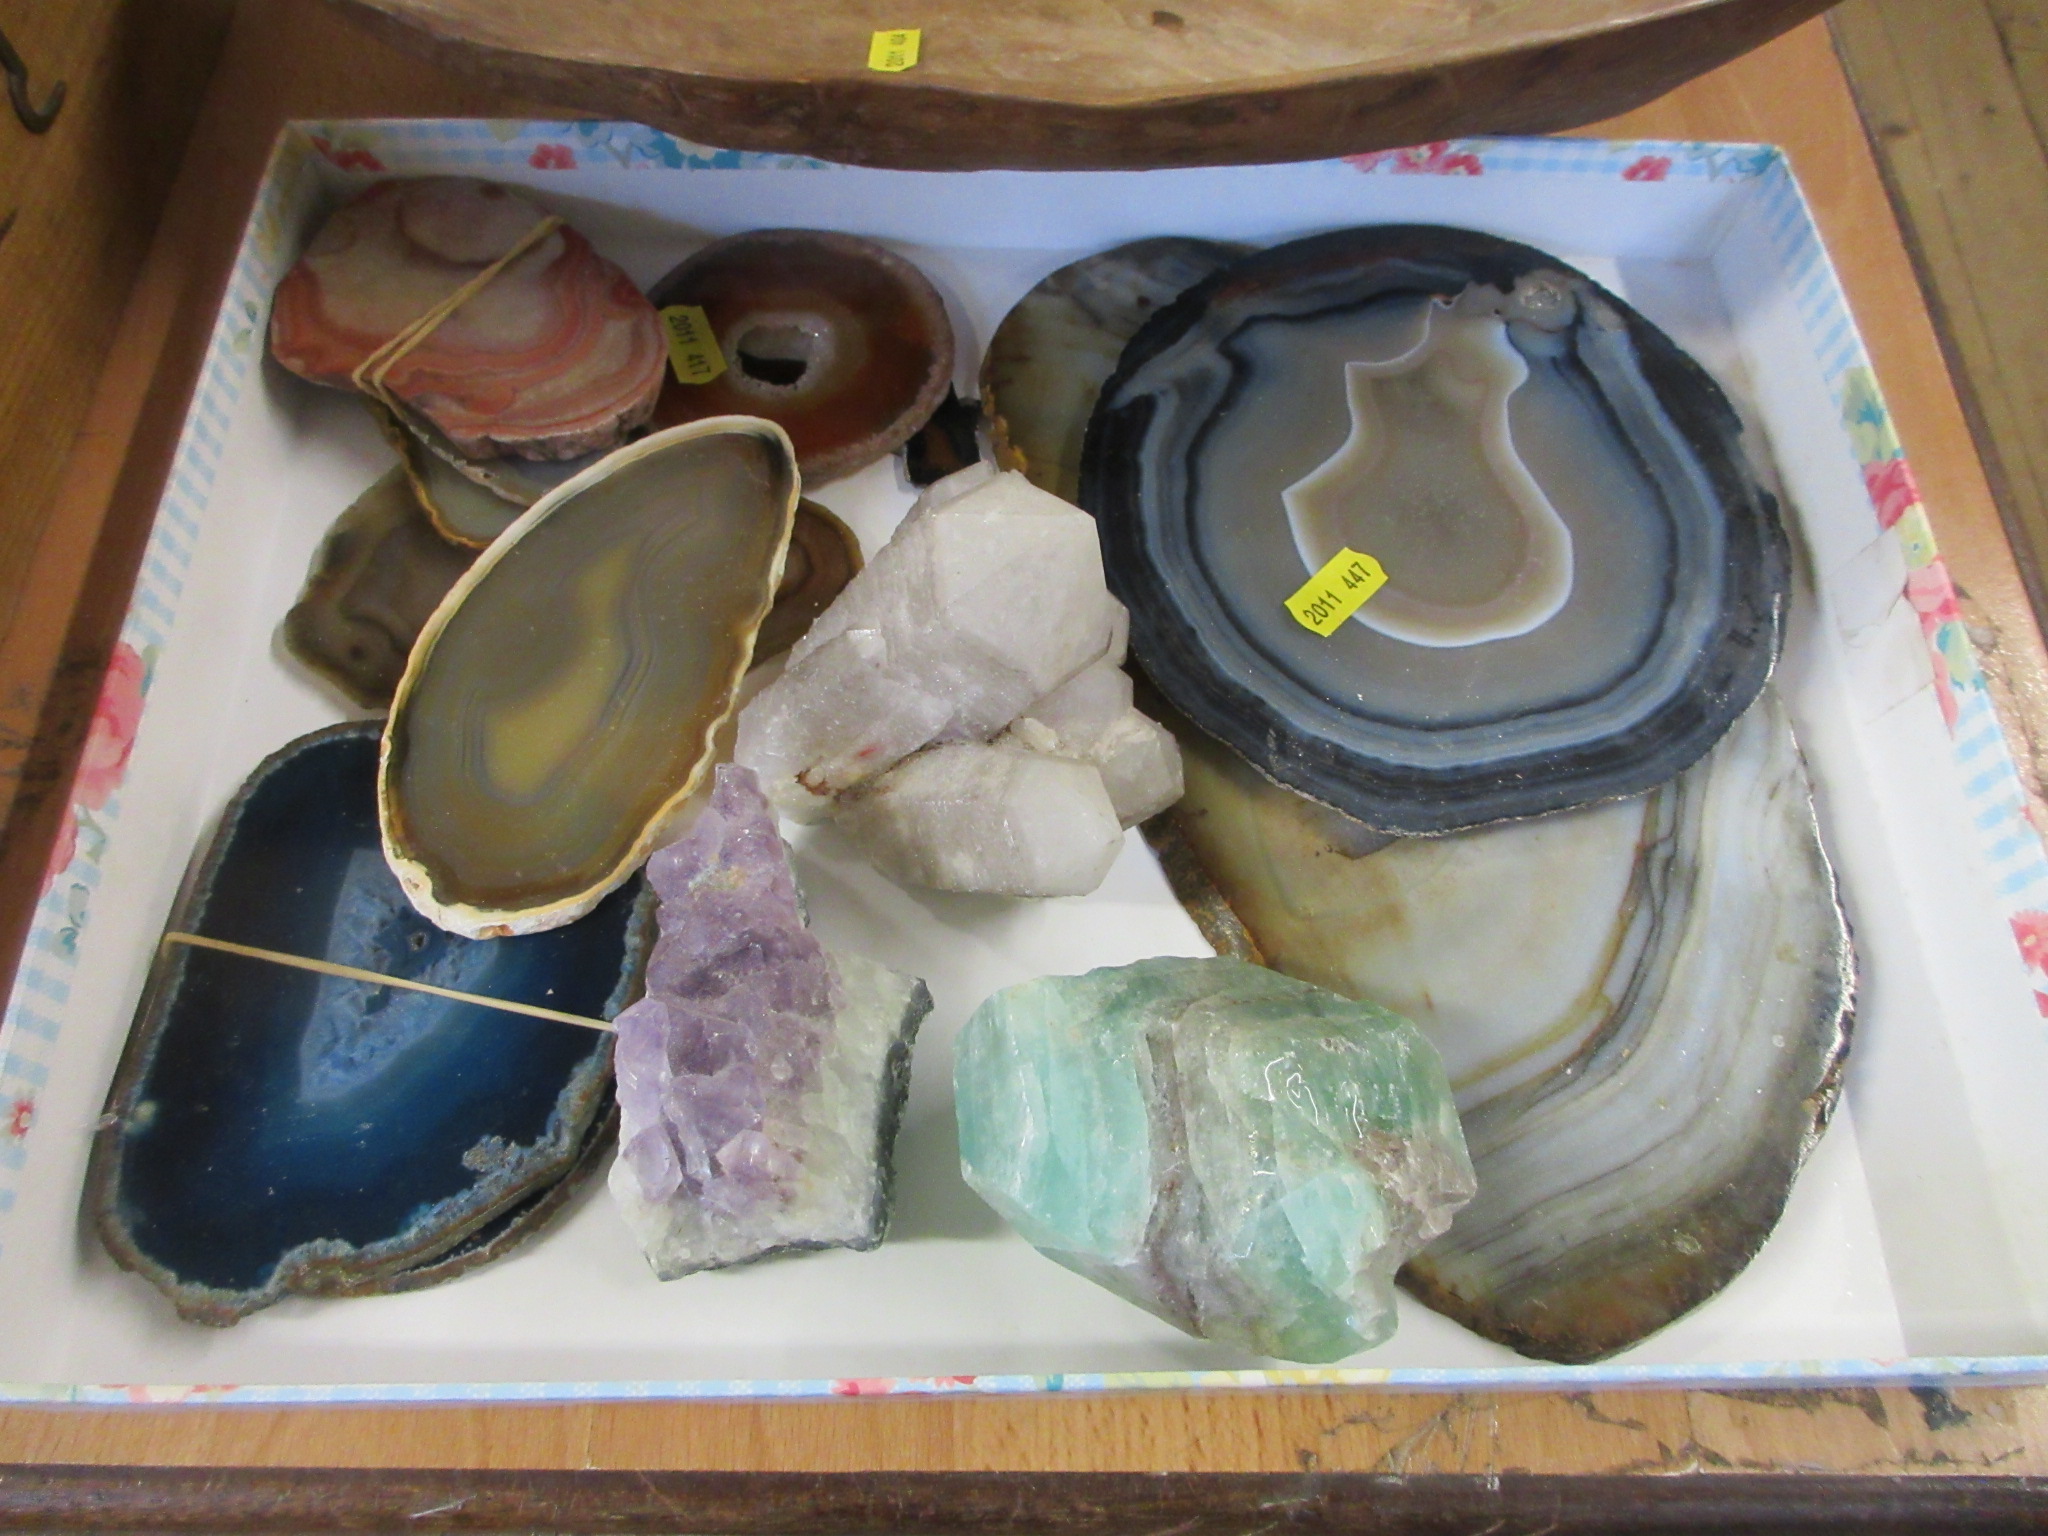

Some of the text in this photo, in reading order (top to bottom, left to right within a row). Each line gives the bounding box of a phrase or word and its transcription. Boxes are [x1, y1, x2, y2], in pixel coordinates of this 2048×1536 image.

[669, 314, 699, 345] 2011
[1302, 561, 1372, 626] 2011 447
